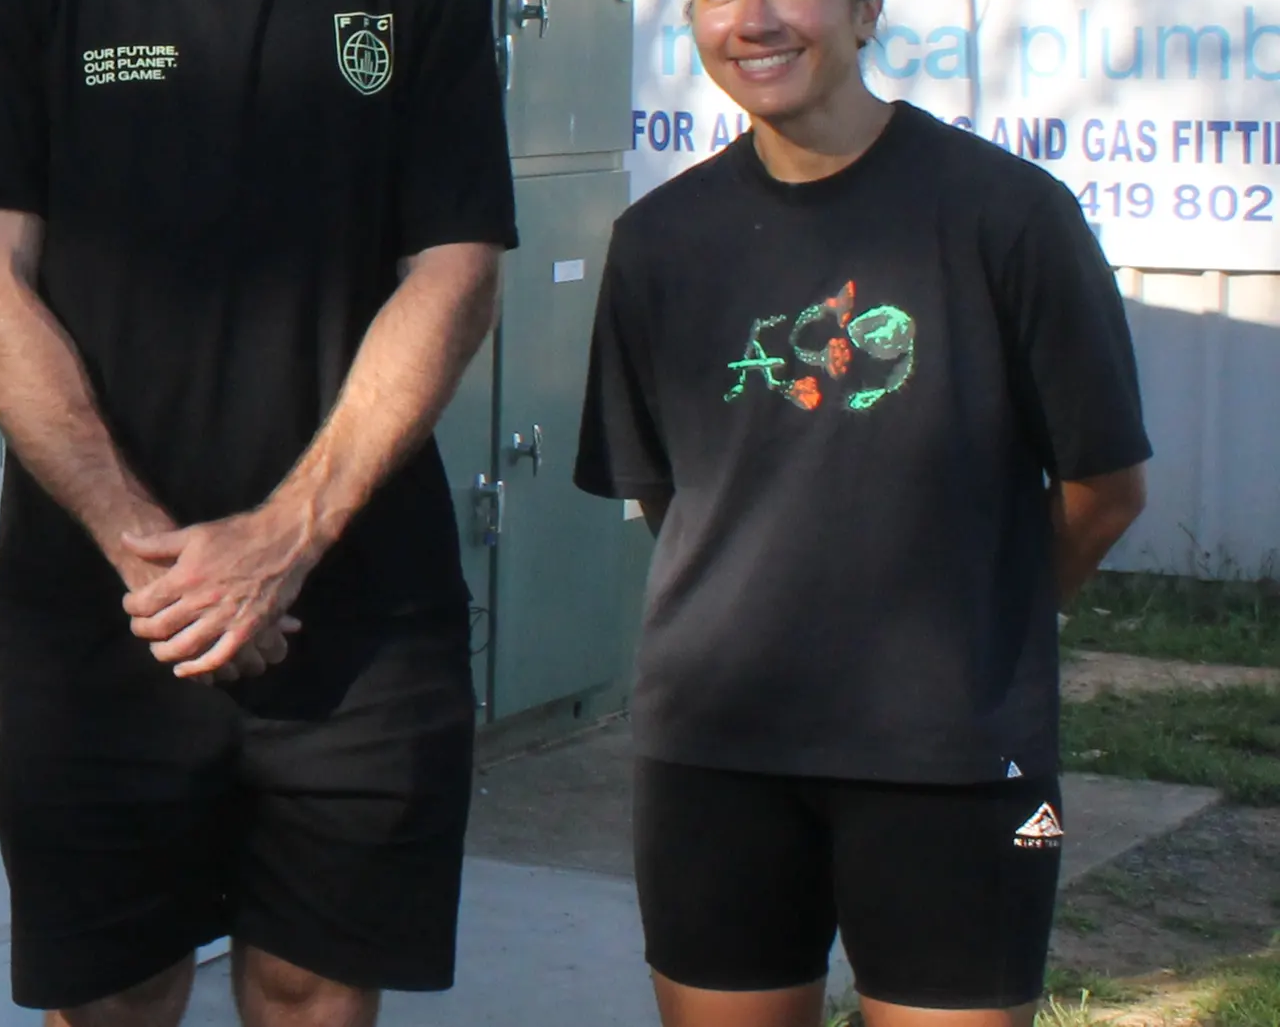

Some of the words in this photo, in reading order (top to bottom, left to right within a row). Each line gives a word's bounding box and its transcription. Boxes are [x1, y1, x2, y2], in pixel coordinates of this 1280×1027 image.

[83, 48, 114, 61] OUR
[117, 45, 179, 57] FUTURE.
[84, 60, 115, 73] OUR
[117, 57, 177, 69] PLANET.
[85, 72, 115, 86] OUR
[118, 69, 165, 81] GAME.
[632, 110, 694, 152] FOR
[990, 117, 1068, 160] AND
[1081, 118, 1158, 162] GAS
[1171, 119, 1280, 165] FITTI
[1171, 182, 1274, 222] 802
